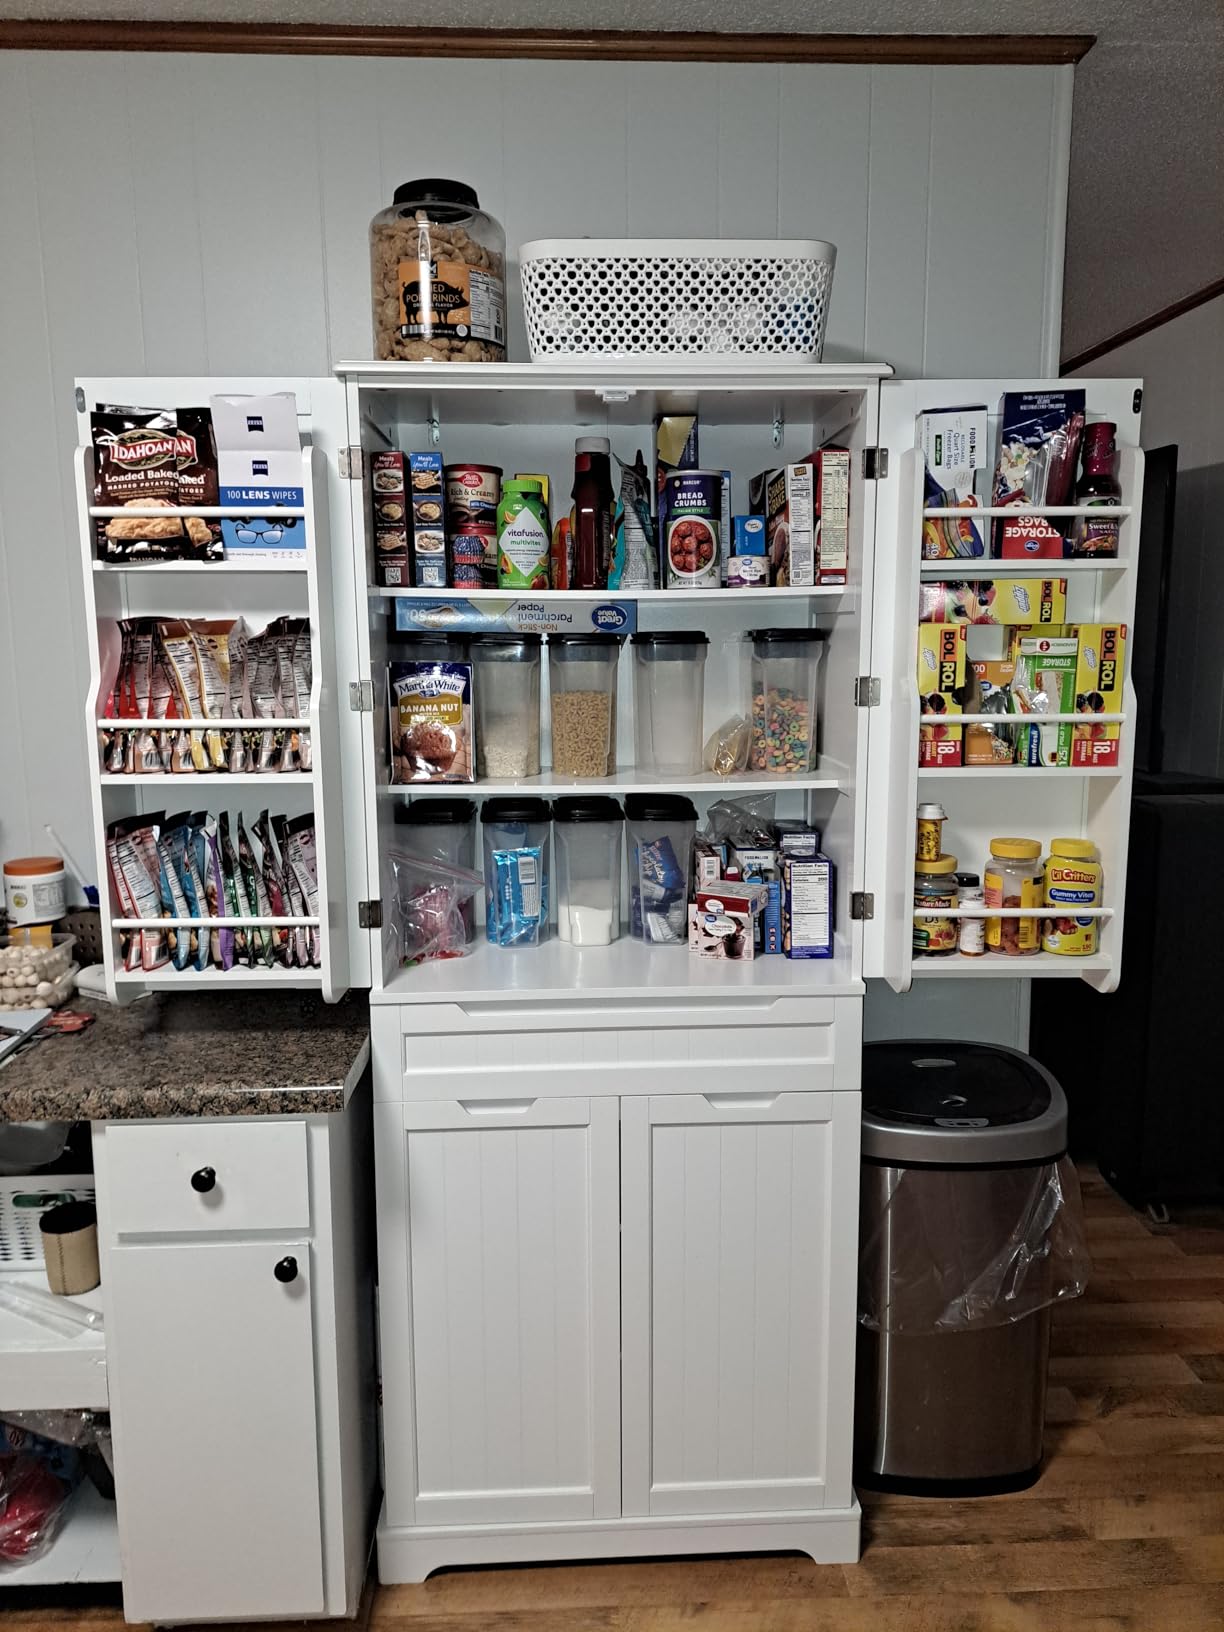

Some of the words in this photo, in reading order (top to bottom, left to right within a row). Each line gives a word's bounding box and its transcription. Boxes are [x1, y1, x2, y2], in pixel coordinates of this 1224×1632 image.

[432, 294, 460, 304] RINDS
[946, 429, 954, 453] Freezer
[114, 441, 173, 460] IDAHOAN
[105, 471, 145, 483] Loaded
[140, 480, 179, 488] POTATOES
[227, 490, 241, 500] 100
[242, 490, 270, 500] LENS
[272, 490, 297, 500] WIPES
[677, 492, 704, 500] BREAD
[674, 499, 707, 507] CRUMBS
[507, 528, 545, 538] vitafusion
[517, 603, 544, 612] Paper
[598, 615, 623, 625] Great
[518, 623, 558, 631] Non-Stick
[1042, 658, 1072, 667] STORAGE
[434, 679, 460, 692] White
[400, 704, 438, 713] BANANA
[440, 703, 459, 712] NUT
[937, 741, 955, 754] 18
[1093, 740, 1111, 754] 18
[1062, 868, 1096, 884] Critters
[1051, 889, 1077, 899] Gummy
